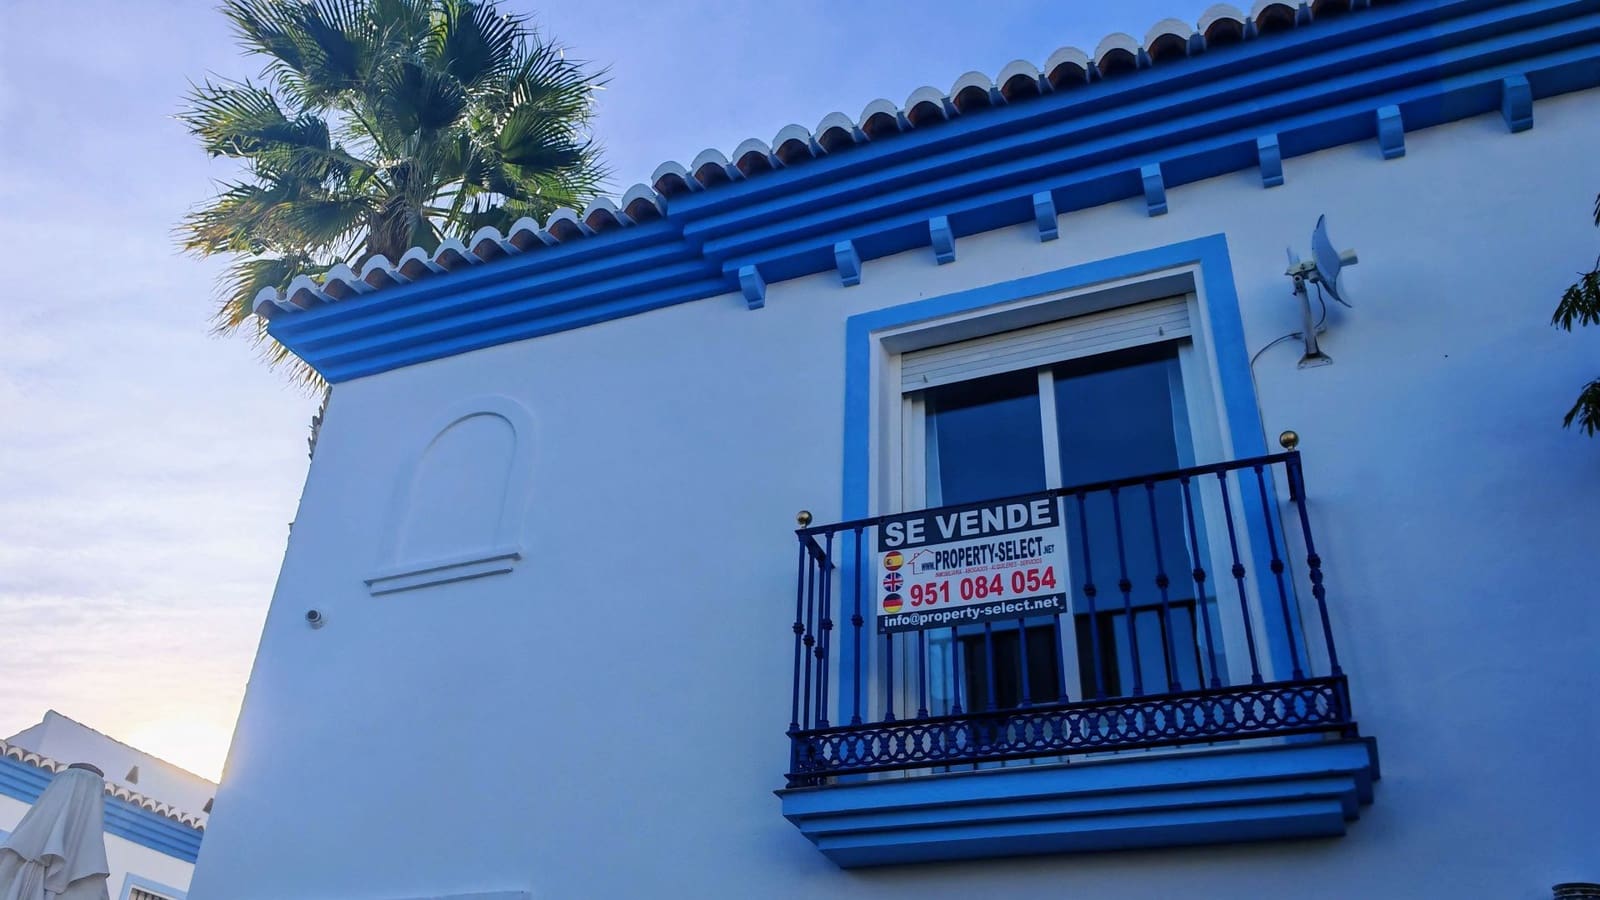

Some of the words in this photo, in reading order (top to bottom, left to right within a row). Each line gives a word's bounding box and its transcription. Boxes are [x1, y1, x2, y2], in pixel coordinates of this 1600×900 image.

[885, 519, 925, 547] SE
[936, 499, 1052, 539] VENDE
[910, 581, 950, 607] 951
[960, 573, 1004, 601] 084
[1011, 566, 1057, 594] 054
[884, 596, 1059, 627] info@property-select.net
